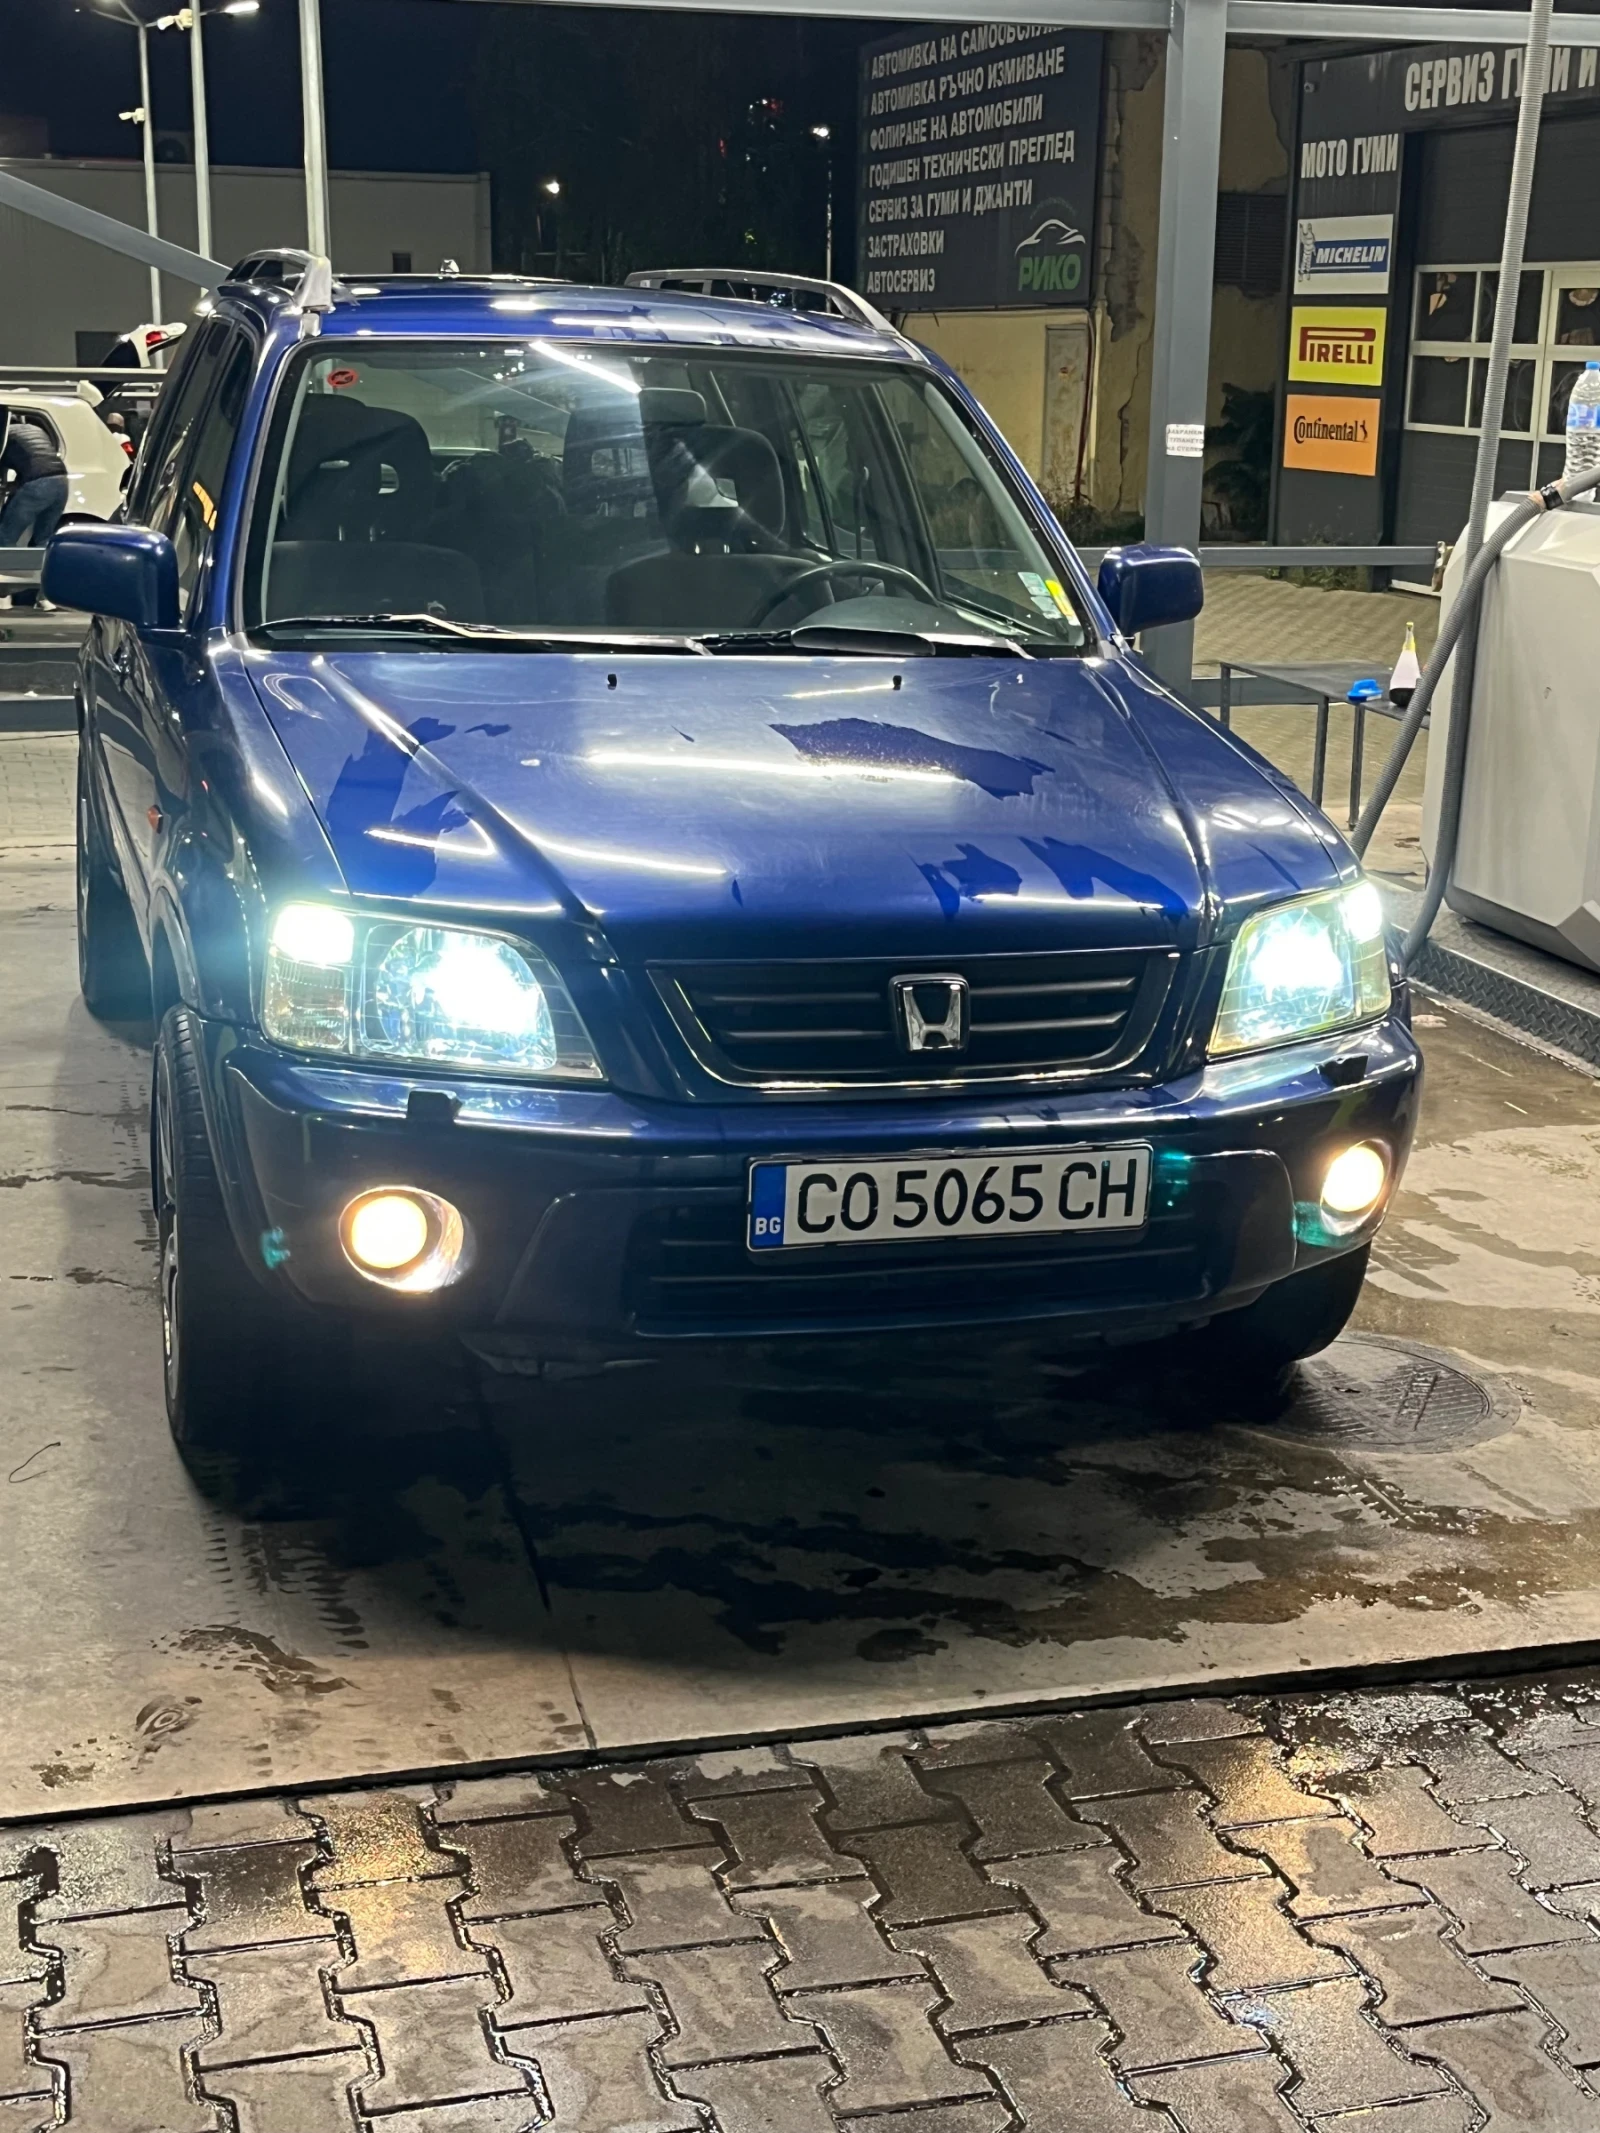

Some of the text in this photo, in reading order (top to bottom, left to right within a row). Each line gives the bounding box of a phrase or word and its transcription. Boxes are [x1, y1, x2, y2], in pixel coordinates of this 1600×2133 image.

[872, 41, 937, 79] АВТОМИВКА
[940, 34, 957, 62] НА
[871, 46, 1065, 115] АВТОМИВКА РЪЧНО ИЗМИВАНЕ
[1404, 51, 1495, 111] СЕРВИЗ
[1578, 48, 1598, 88] И
[870, 94, 1043, 151] ФОЛИРАНЕ НА АВТОМОБИЛИ
[869, 130, 1075, 190] ГОДИШЕН ТЕХНИЧЕСКИ ПРЕГЛЕД
[1301, 133, 1398, 179] МОТО ГУМИ
[868, 196, 908, 223] СЕРВИЗ
[910, 195, 924, 219] ЗА
[926, 188, 960, 217] ГУМИ
[962, 187, 971, 212] И
[973, 179, 1033, 216] ДЖАНТИ
[868, 230, 945, 258] ЗАСТРАХОВКИ
[1315, 246, 1387, 264] MICHELIN
[867, 268, 935, 294] АВТОСЕРВИЗ
[1018, 254, 1081, 292] РИКО
[1298, 326, 1377, 365] PIRELLI
[1293, 415, 1359, 444] Continental
[797, 1158, 1138, 1233] CO 5065 CH
[754, 1216, 781, 1236] BG
